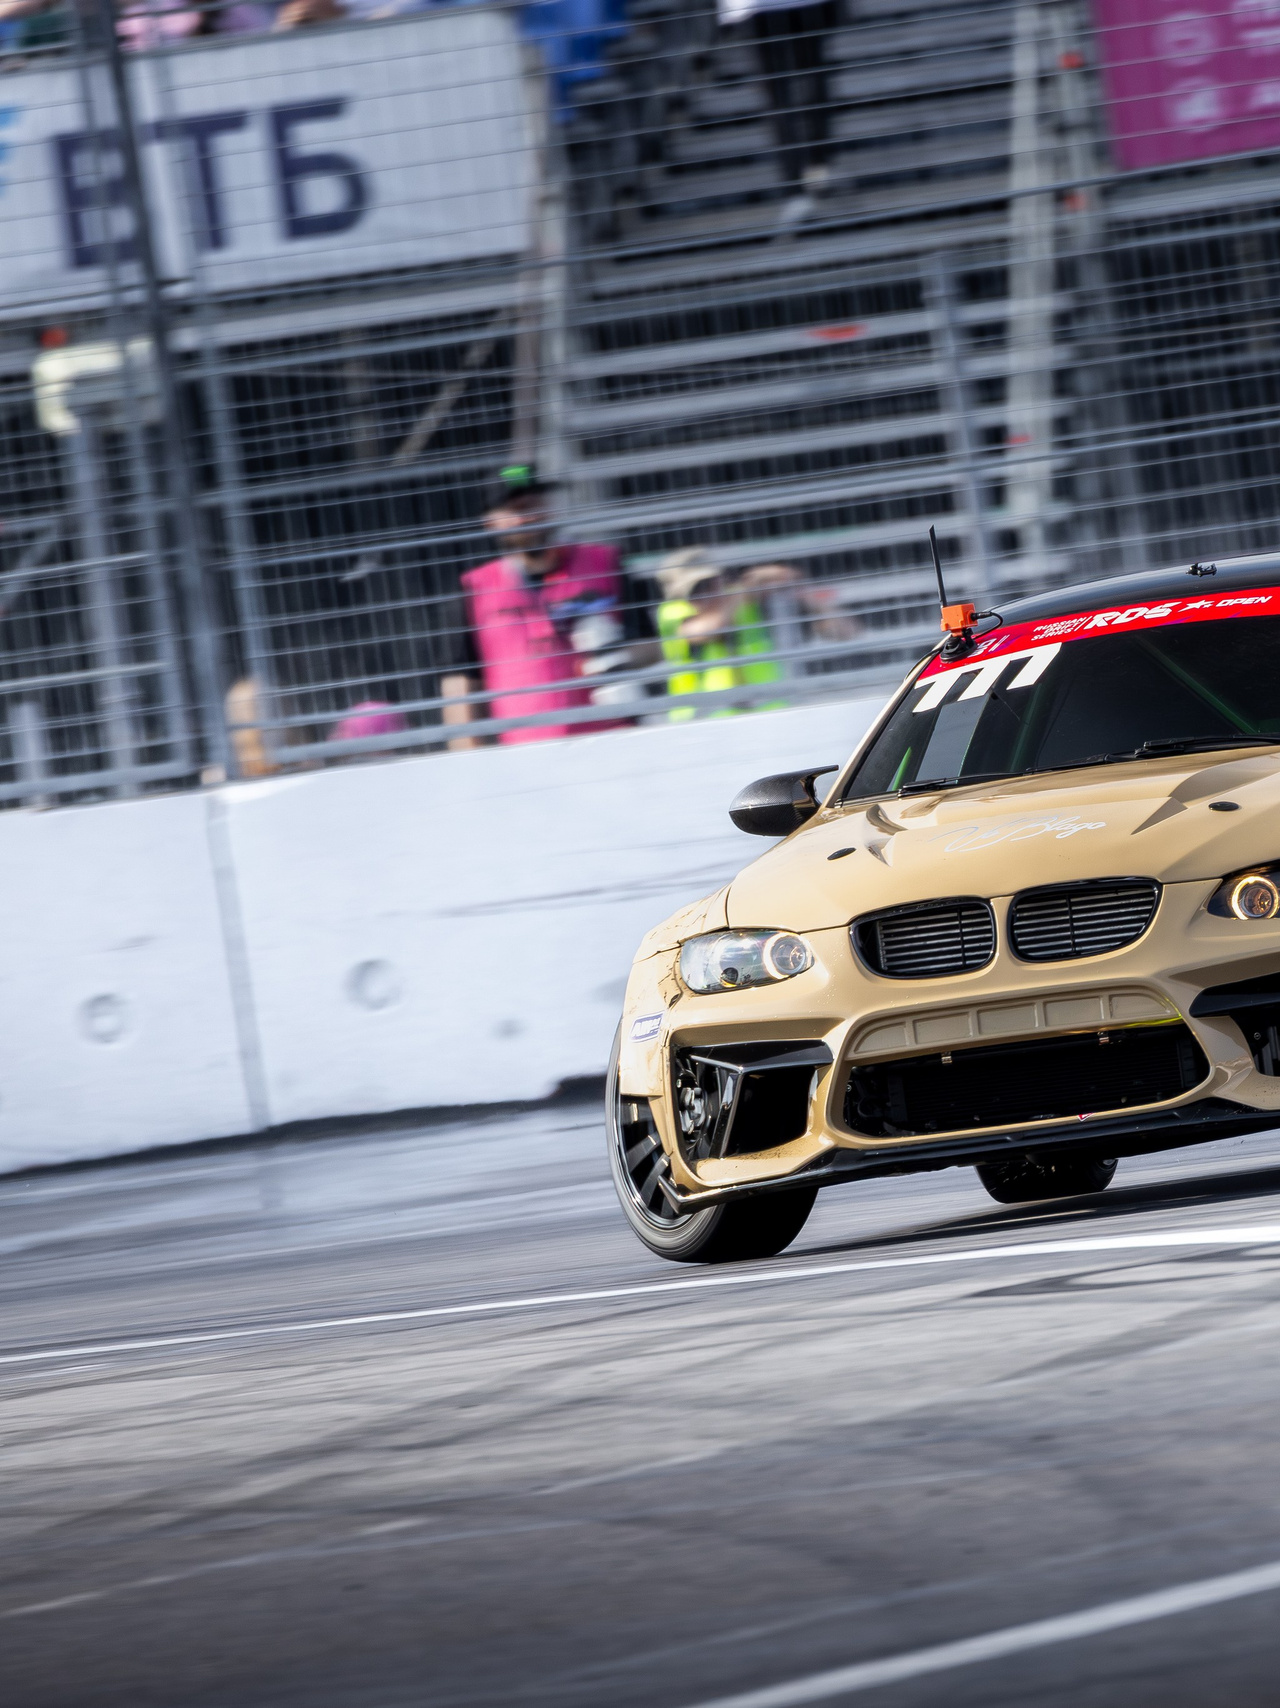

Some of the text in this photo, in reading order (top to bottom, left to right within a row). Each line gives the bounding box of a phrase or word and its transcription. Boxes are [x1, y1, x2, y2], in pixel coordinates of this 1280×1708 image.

[51, 96, 373, 269] ВТБ
[1083, 601, 1182, 630] RDS
[1215, 595, 1273, 608] OPEN
